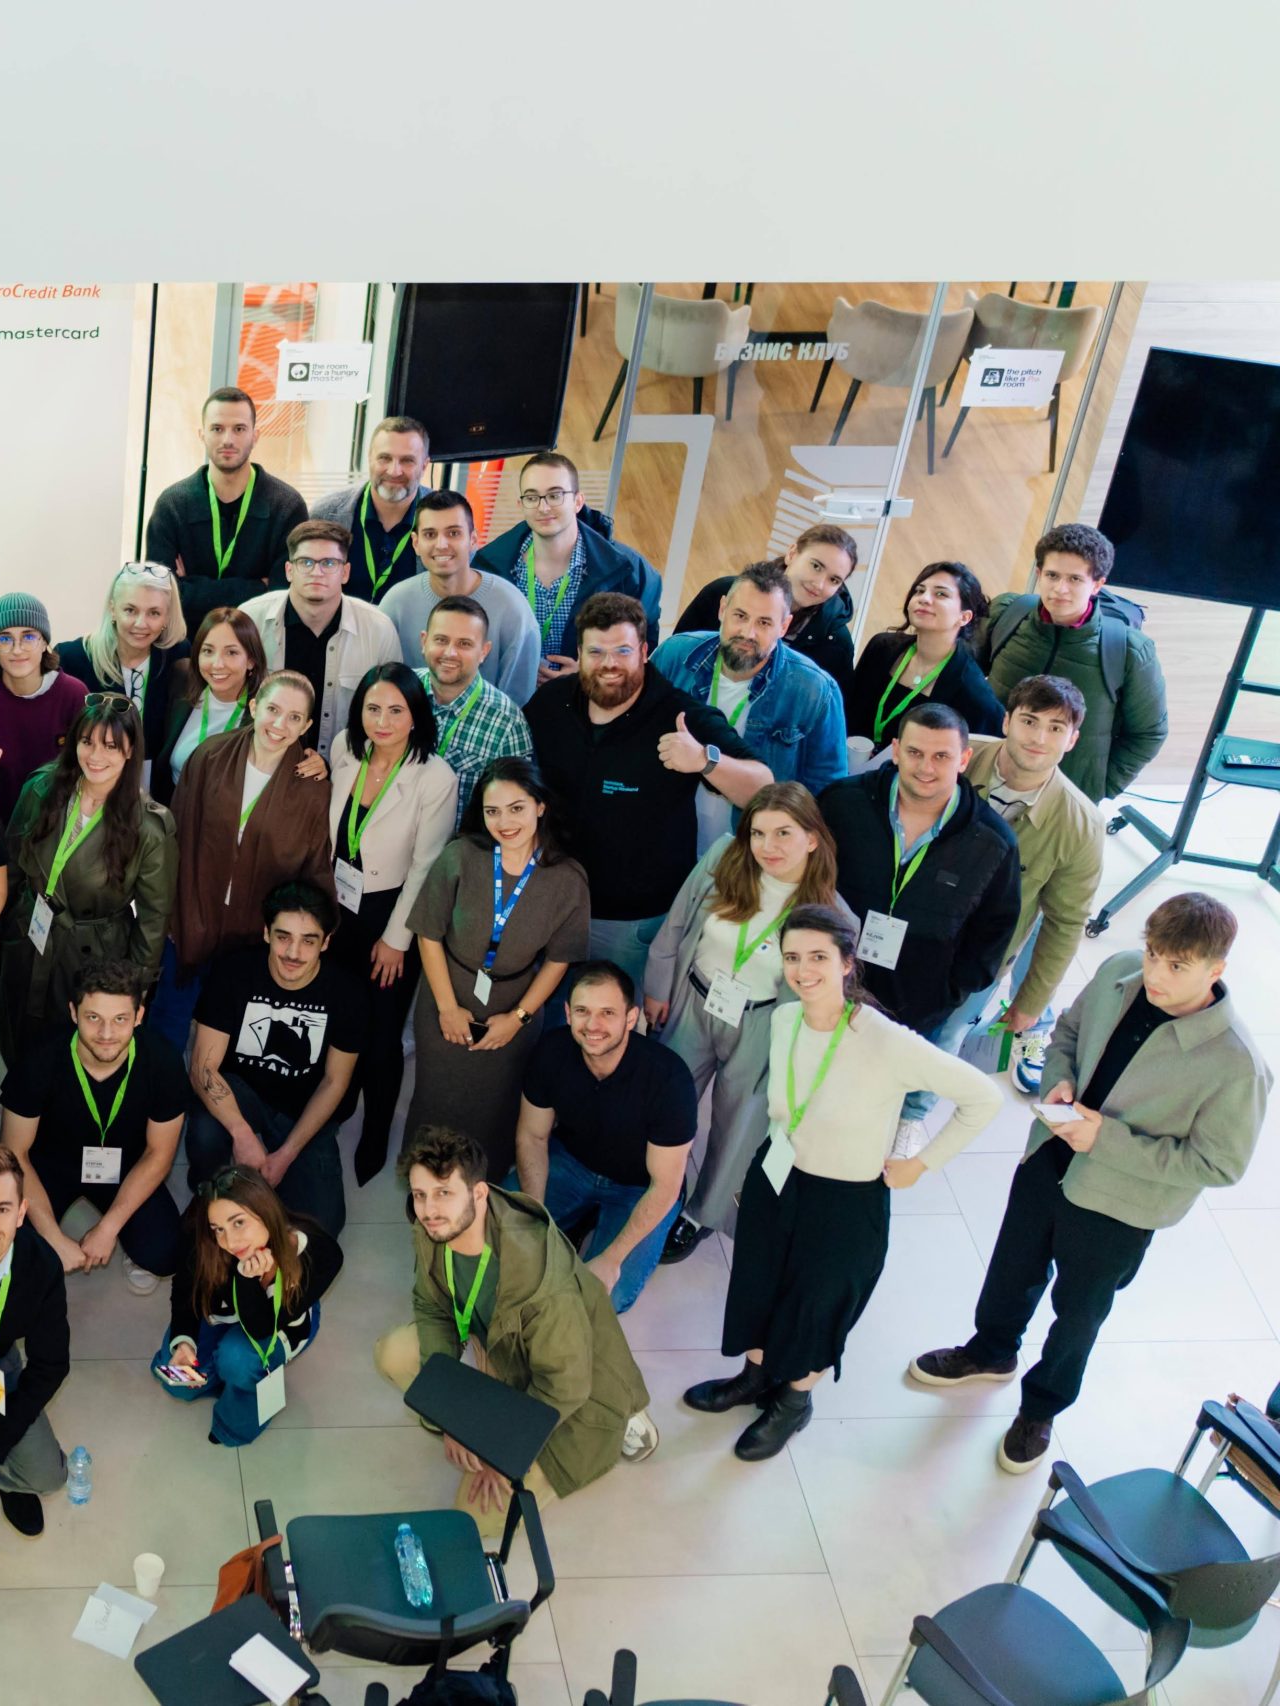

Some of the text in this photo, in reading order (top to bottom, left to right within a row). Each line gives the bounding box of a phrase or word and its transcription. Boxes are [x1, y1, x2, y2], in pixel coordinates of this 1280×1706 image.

[62, 284, 101, 298] Bank
[714, 342, 850, 361] БИЗНИС КЛУБ
[1021, 368, 1042, 376] pitch
